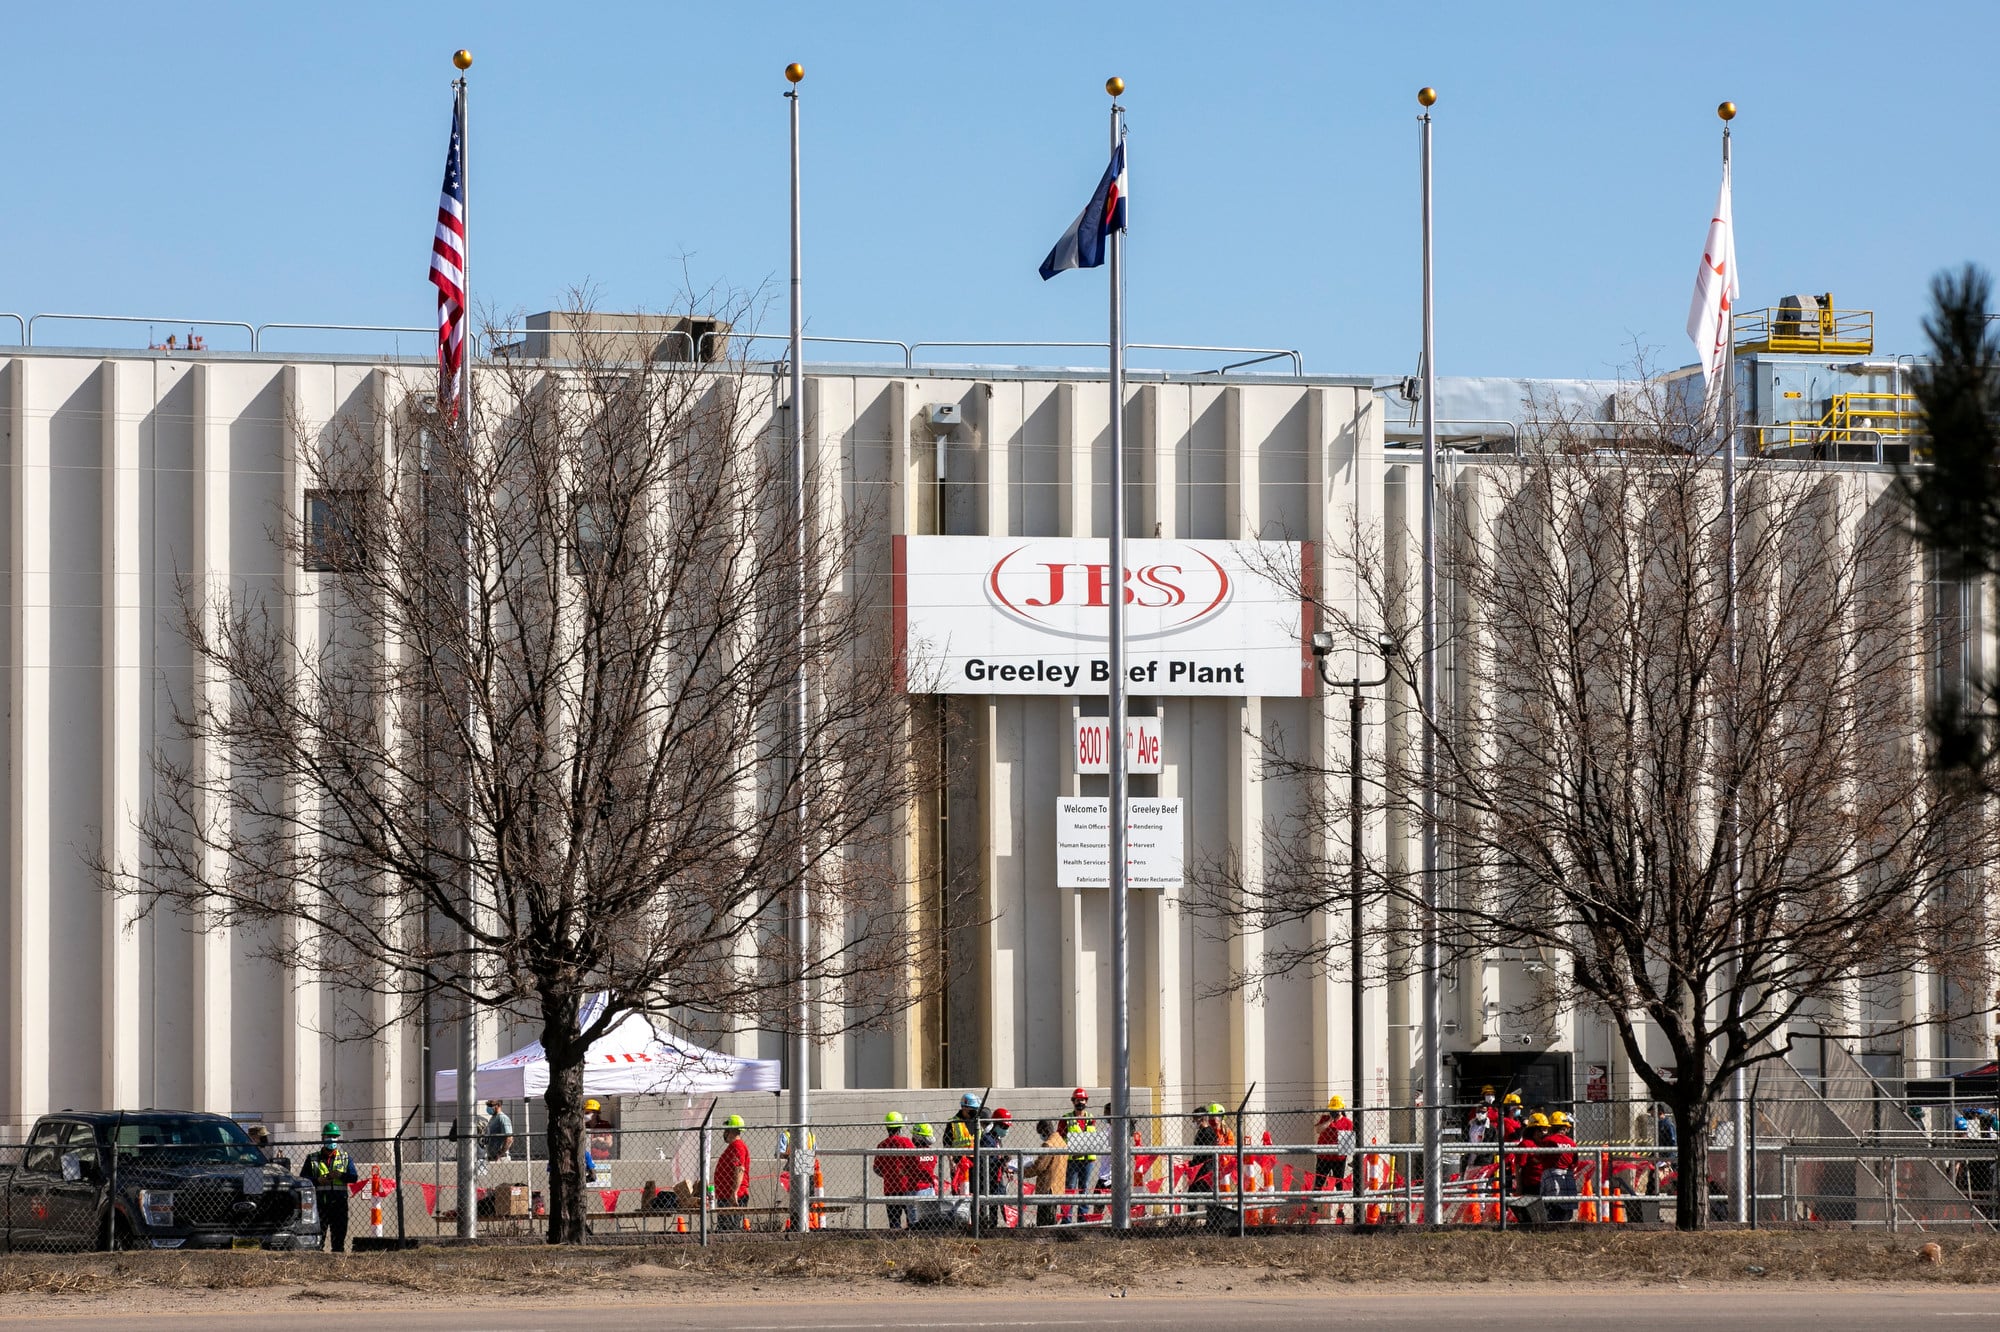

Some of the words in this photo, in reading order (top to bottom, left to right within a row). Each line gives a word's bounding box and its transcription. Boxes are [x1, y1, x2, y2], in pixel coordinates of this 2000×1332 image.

[1025, 562, 1186, 607] JBS
[965, 659, 1079, 688] Greeley
[1090, 659, 1157, 682] Bef
[1169, 661, 1244, 684] Plant
[1079, 726, 1101, 764] 800
[1138, 726, 1158, 764] Ave
[1064, 804, 1097, 814] Welcome
[1099, 804, 1107, 814] To
[1132, 804, 1160, 815] Greeley
[1162, 804, 1178, 814] Beef
[1133, 823, 1163, 831] Rendering
[1063, 858, 1082, 866] Health
[1083, 858, 1106, 866] Services
